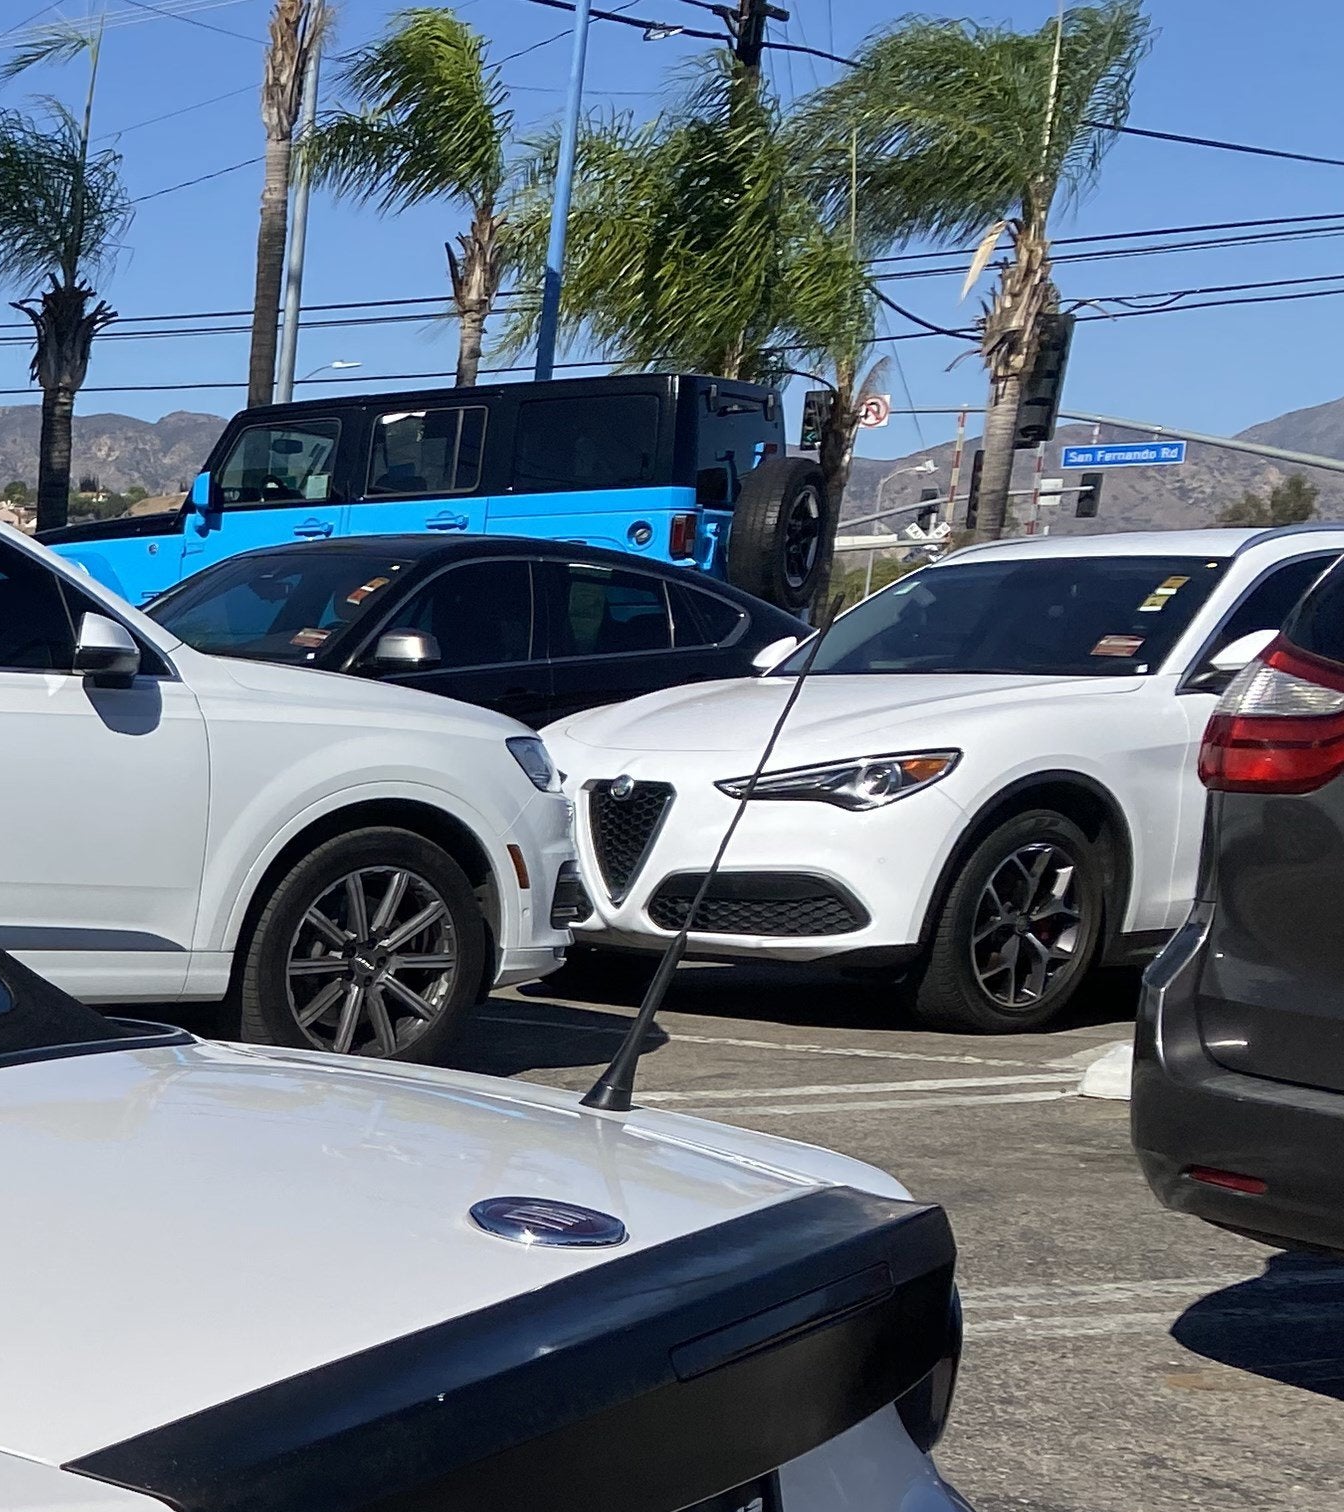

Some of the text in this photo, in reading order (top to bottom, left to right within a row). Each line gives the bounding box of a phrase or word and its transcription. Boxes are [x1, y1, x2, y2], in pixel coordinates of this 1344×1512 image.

[1069, 447, 1179, 463] San Fernando Rd
